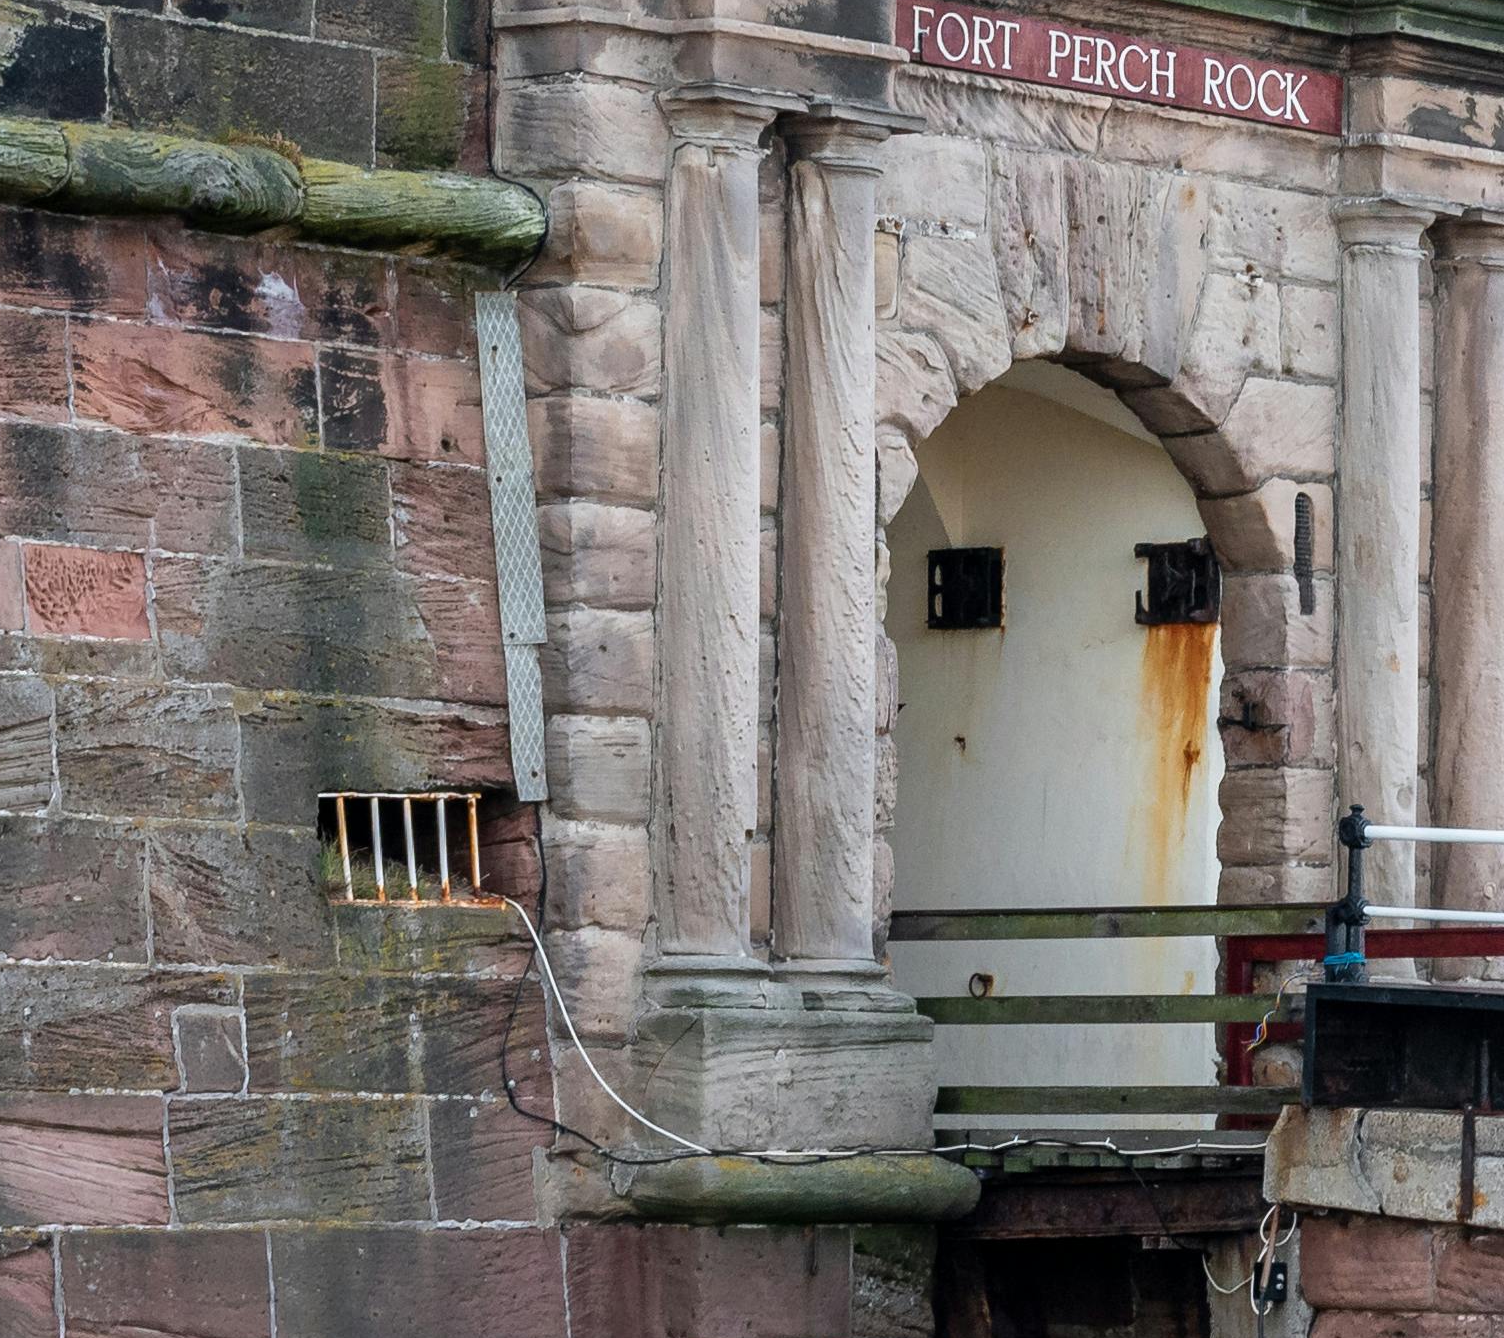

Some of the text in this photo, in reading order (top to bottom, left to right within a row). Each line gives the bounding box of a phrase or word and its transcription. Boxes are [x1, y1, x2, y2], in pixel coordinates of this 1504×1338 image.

[911, 5, 1310, 125] FORT PERCH ROCK
